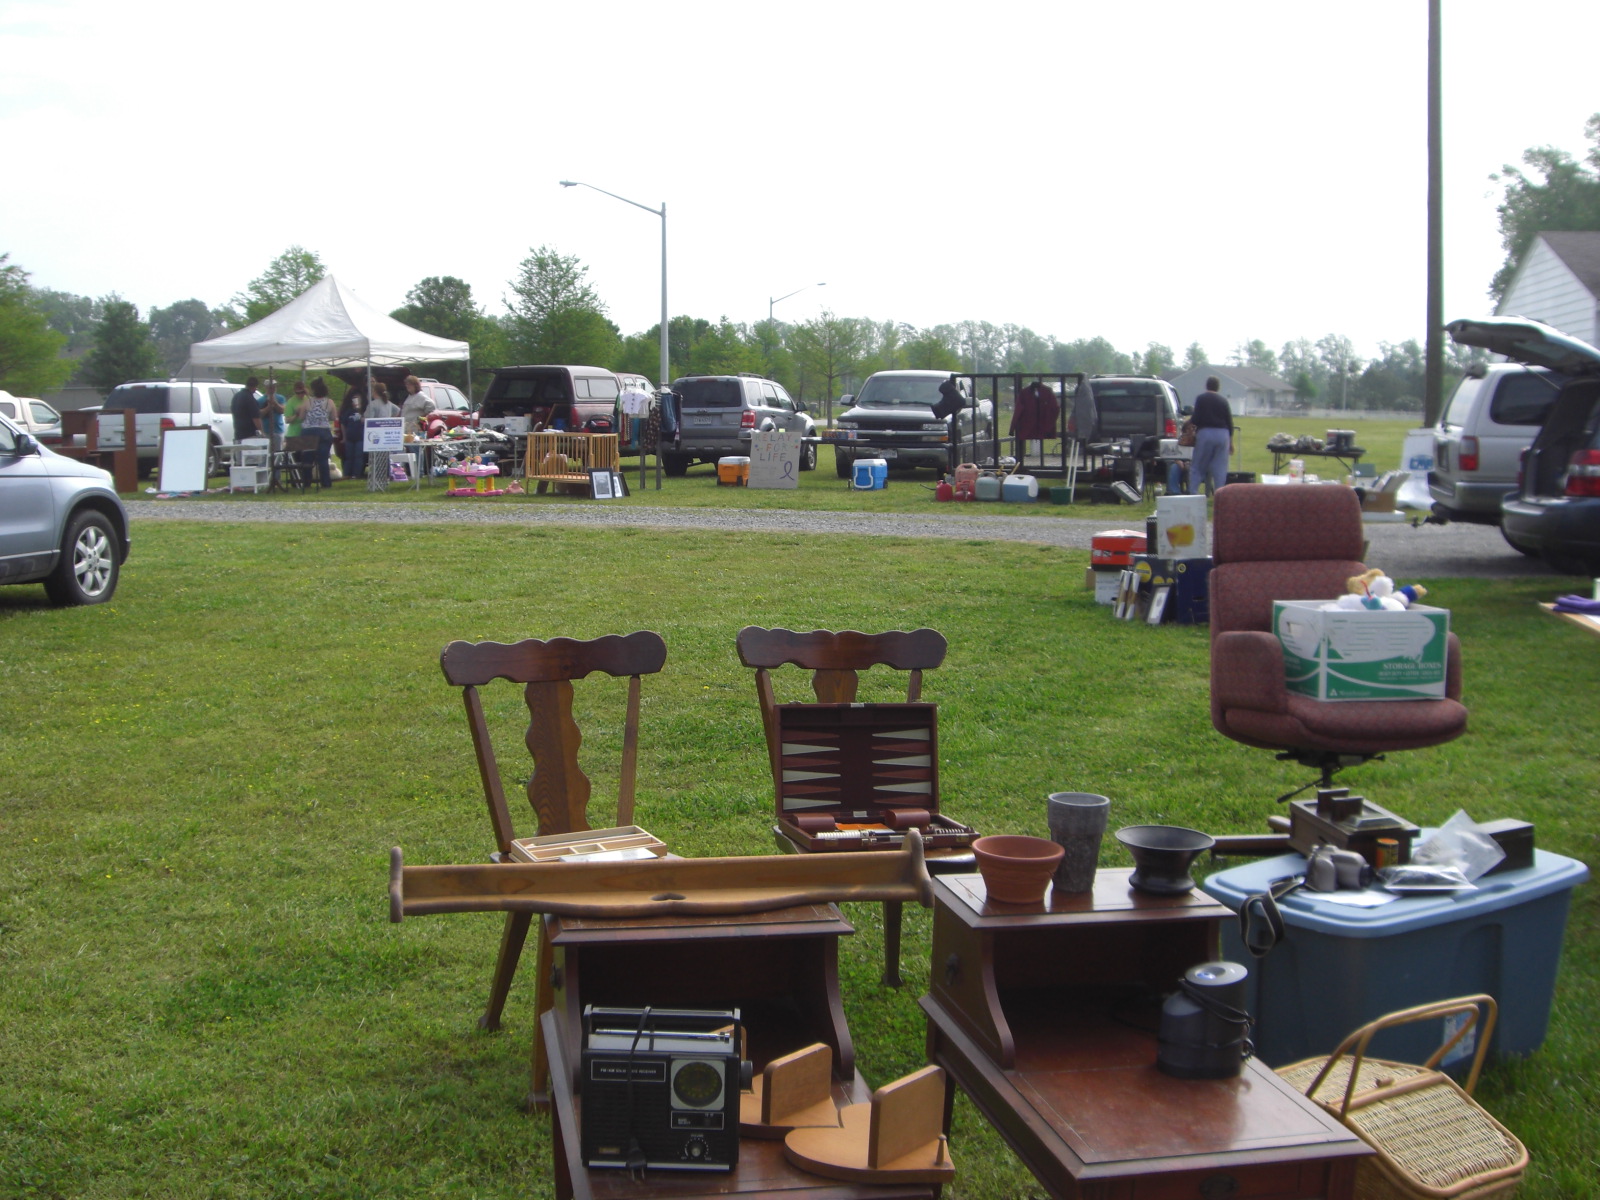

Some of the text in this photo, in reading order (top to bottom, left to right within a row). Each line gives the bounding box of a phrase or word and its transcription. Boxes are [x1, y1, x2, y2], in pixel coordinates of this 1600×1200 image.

[755, 433, 793, 442] RELAY
[766, 442, 788, 452] FOR
[759, 451, 787, 463] LIFE
